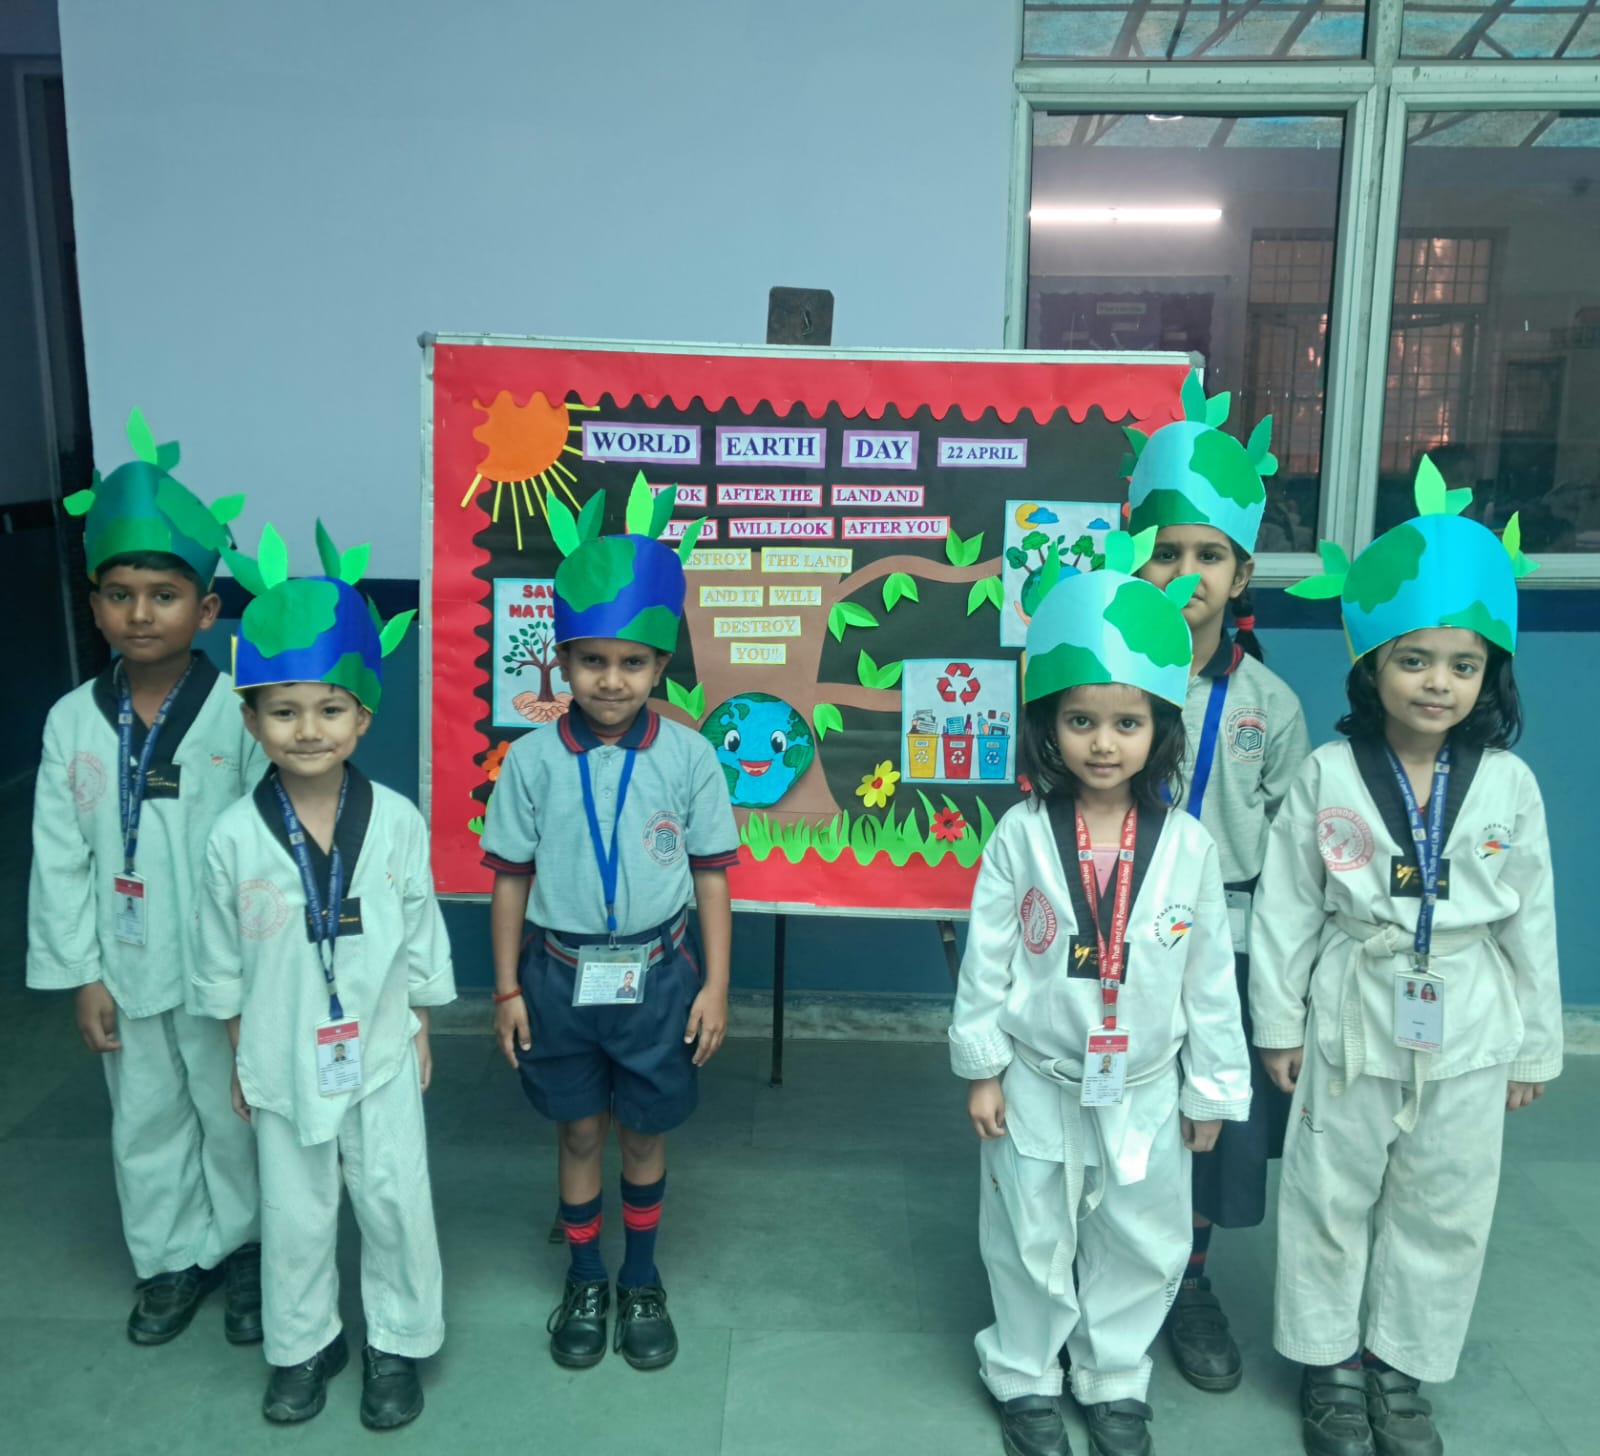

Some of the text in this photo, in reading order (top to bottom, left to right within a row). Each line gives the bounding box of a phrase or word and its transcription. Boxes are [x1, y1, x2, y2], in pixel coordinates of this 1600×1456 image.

[592, 431, 1018, 461] WORLD EARTH DAY 22 APRIL
[722, 488, 776, 501] AFTER
[780, 488, 813, 502] THE
[836, 489, 882, 502] LAND
[884, 490, 920, 503] AND
[734, 522, 777, 535] WILL
[780, 522, 828, 535] LOOK
[848, 521, 902, 534] AFTER
[905, 520, 941, 533] YOU
[766, 554, 800, 567] THE
[803, 555, 849, 568] LAND
[705, 589, 817, 602] AND IT WILL
[720, 619, 796, 634] DESTROY
[1432, 796, 1442, 830] Foundation
[1431, 831, 1440, 843] Life
[1430, 844, 1438, 856] and
[1428, 858, 1437, 873] Truth
[1120, 863, 1130, 884] School
[1116, 885, 1127, 919] Foundation
[1115, 919, 1124, 931] Life
[1114, 931, 1122, 943] and
[1112, 944, 1121, 960] Truth
